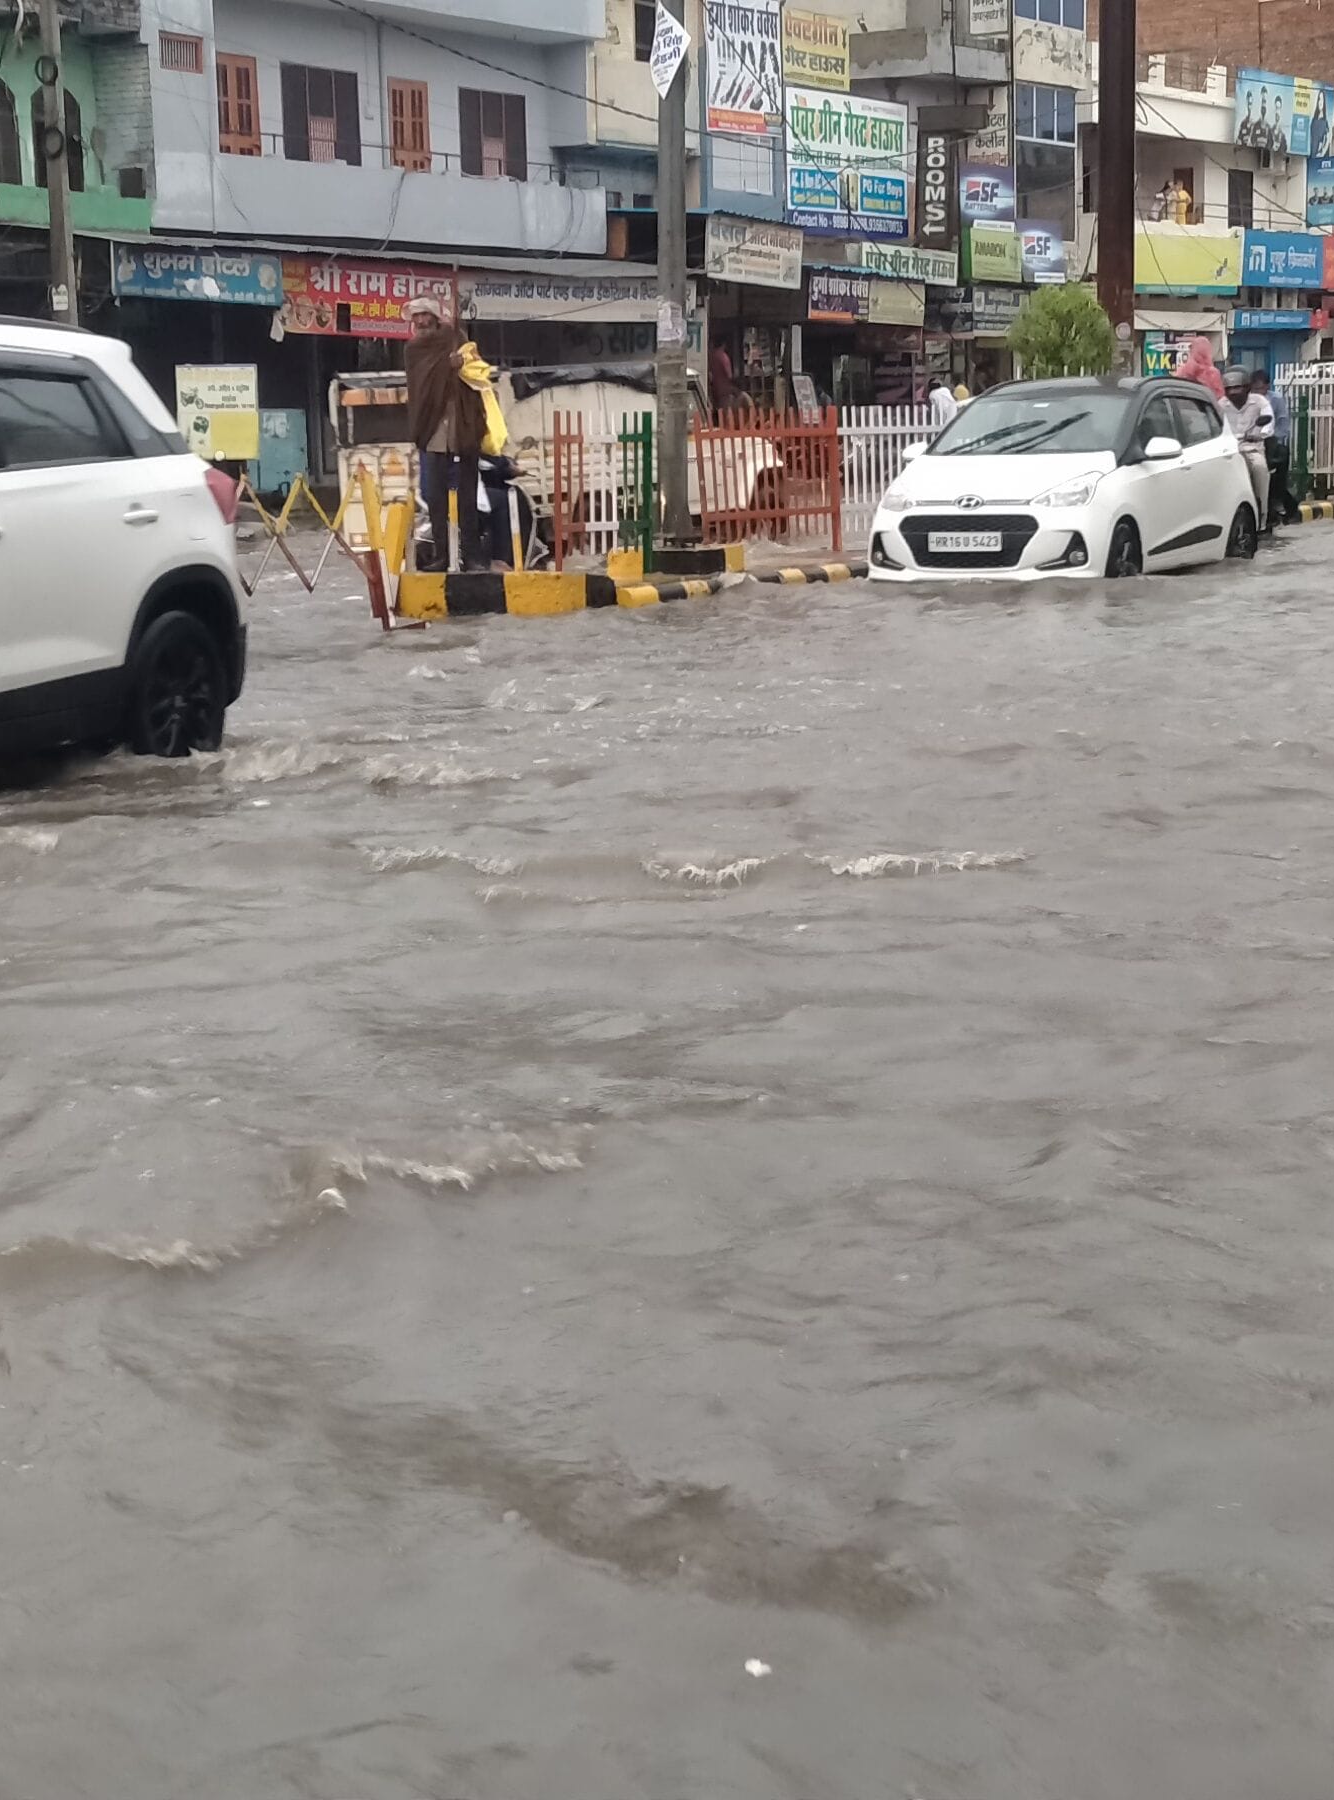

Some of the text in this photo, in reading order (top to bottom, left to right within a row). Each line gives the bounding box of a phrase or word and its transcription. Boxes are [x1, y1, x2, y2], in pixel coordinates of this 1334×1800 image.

[924, 137, 947, 222] ROOMS
[792, 211, 818, 227] Contact
[818, 213, 828, 228] No
[309, 262, 342, 294] श्री
[346, 269, 388, 298] राम
[971, 535, 1000, 548] 5423
